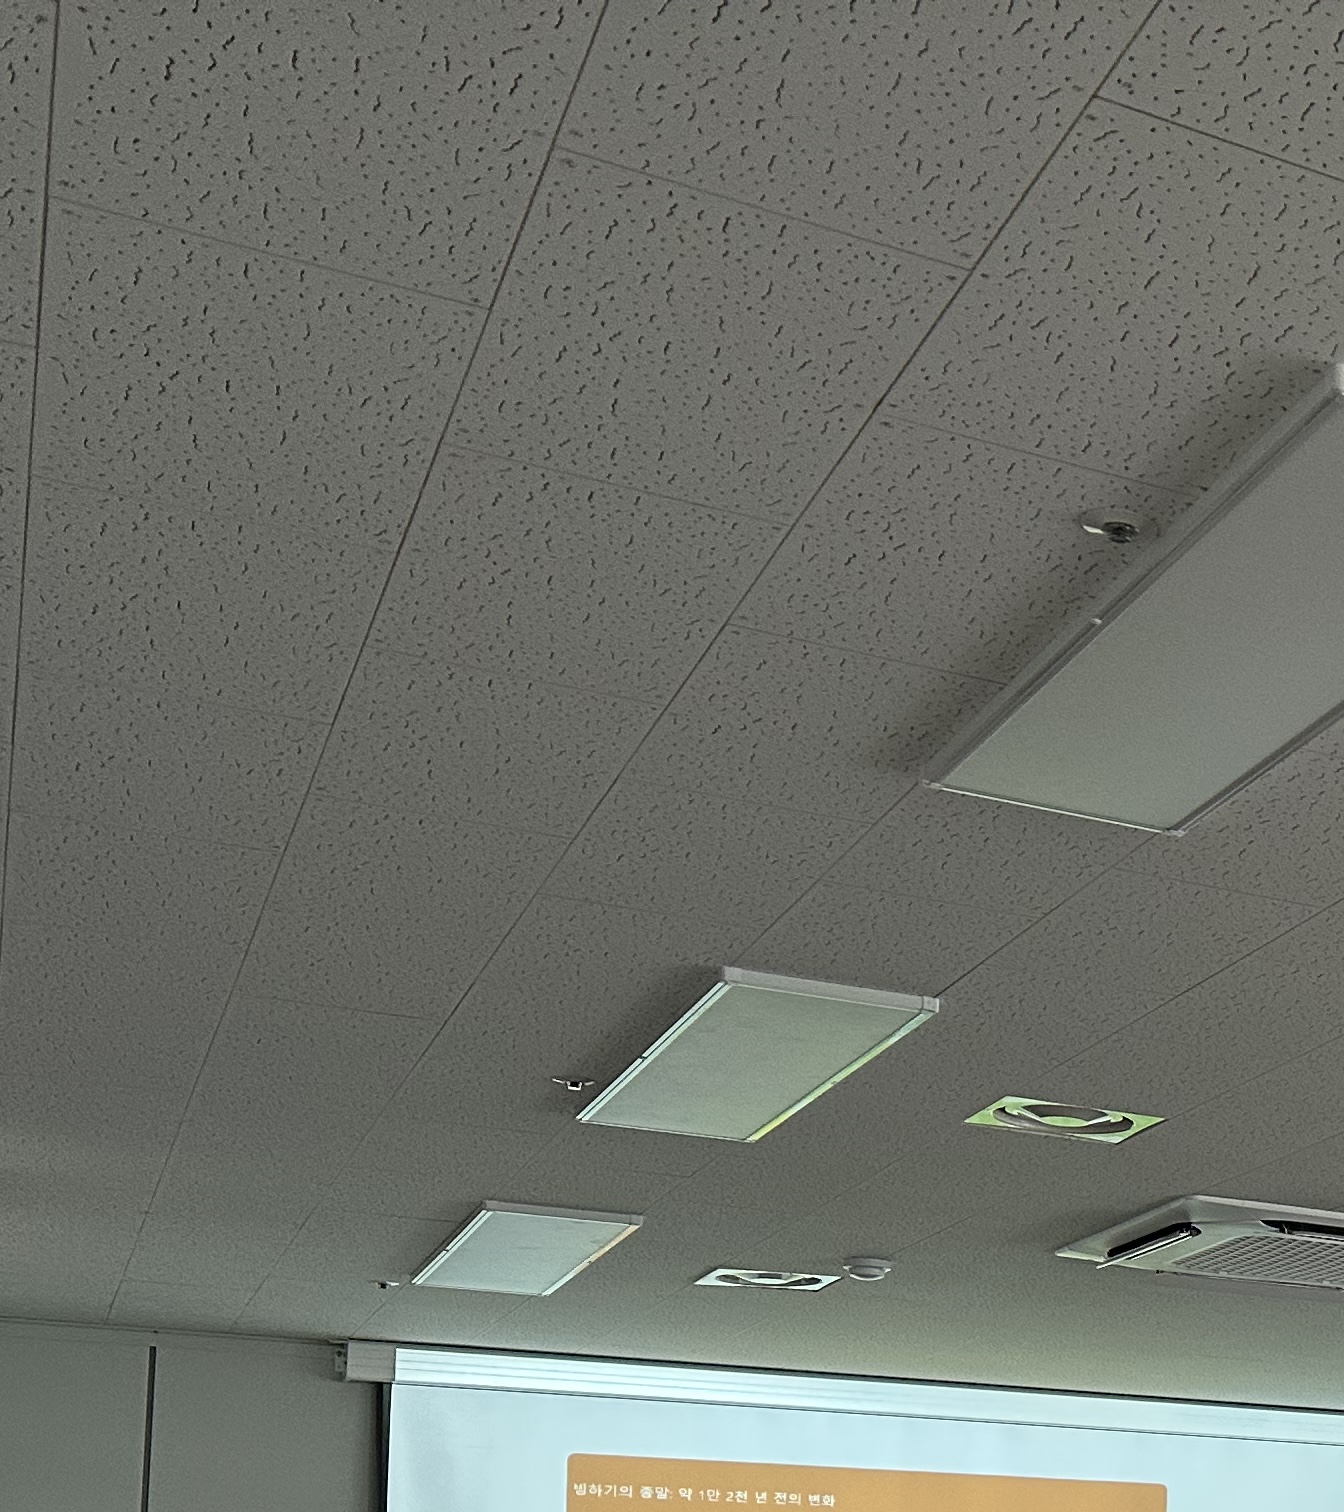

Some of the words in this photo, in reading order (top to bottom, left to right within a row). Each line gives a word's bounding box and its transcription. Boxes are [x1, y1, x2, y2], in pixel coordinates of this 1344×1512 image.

[573, 1482, 633, 1499] 빙하기의
[639, 1485, 673, 1500] 종말:
[678, 1487, 693, 1501] 약
[698, 1488, 721, 1502] 1만
[725, 1490, 748, 1504] 2천
[755, 1491, 768, 1505] 년
[773, 1491, 802, 1506] 전의
[808, 1493, 836, 1508] 변화
